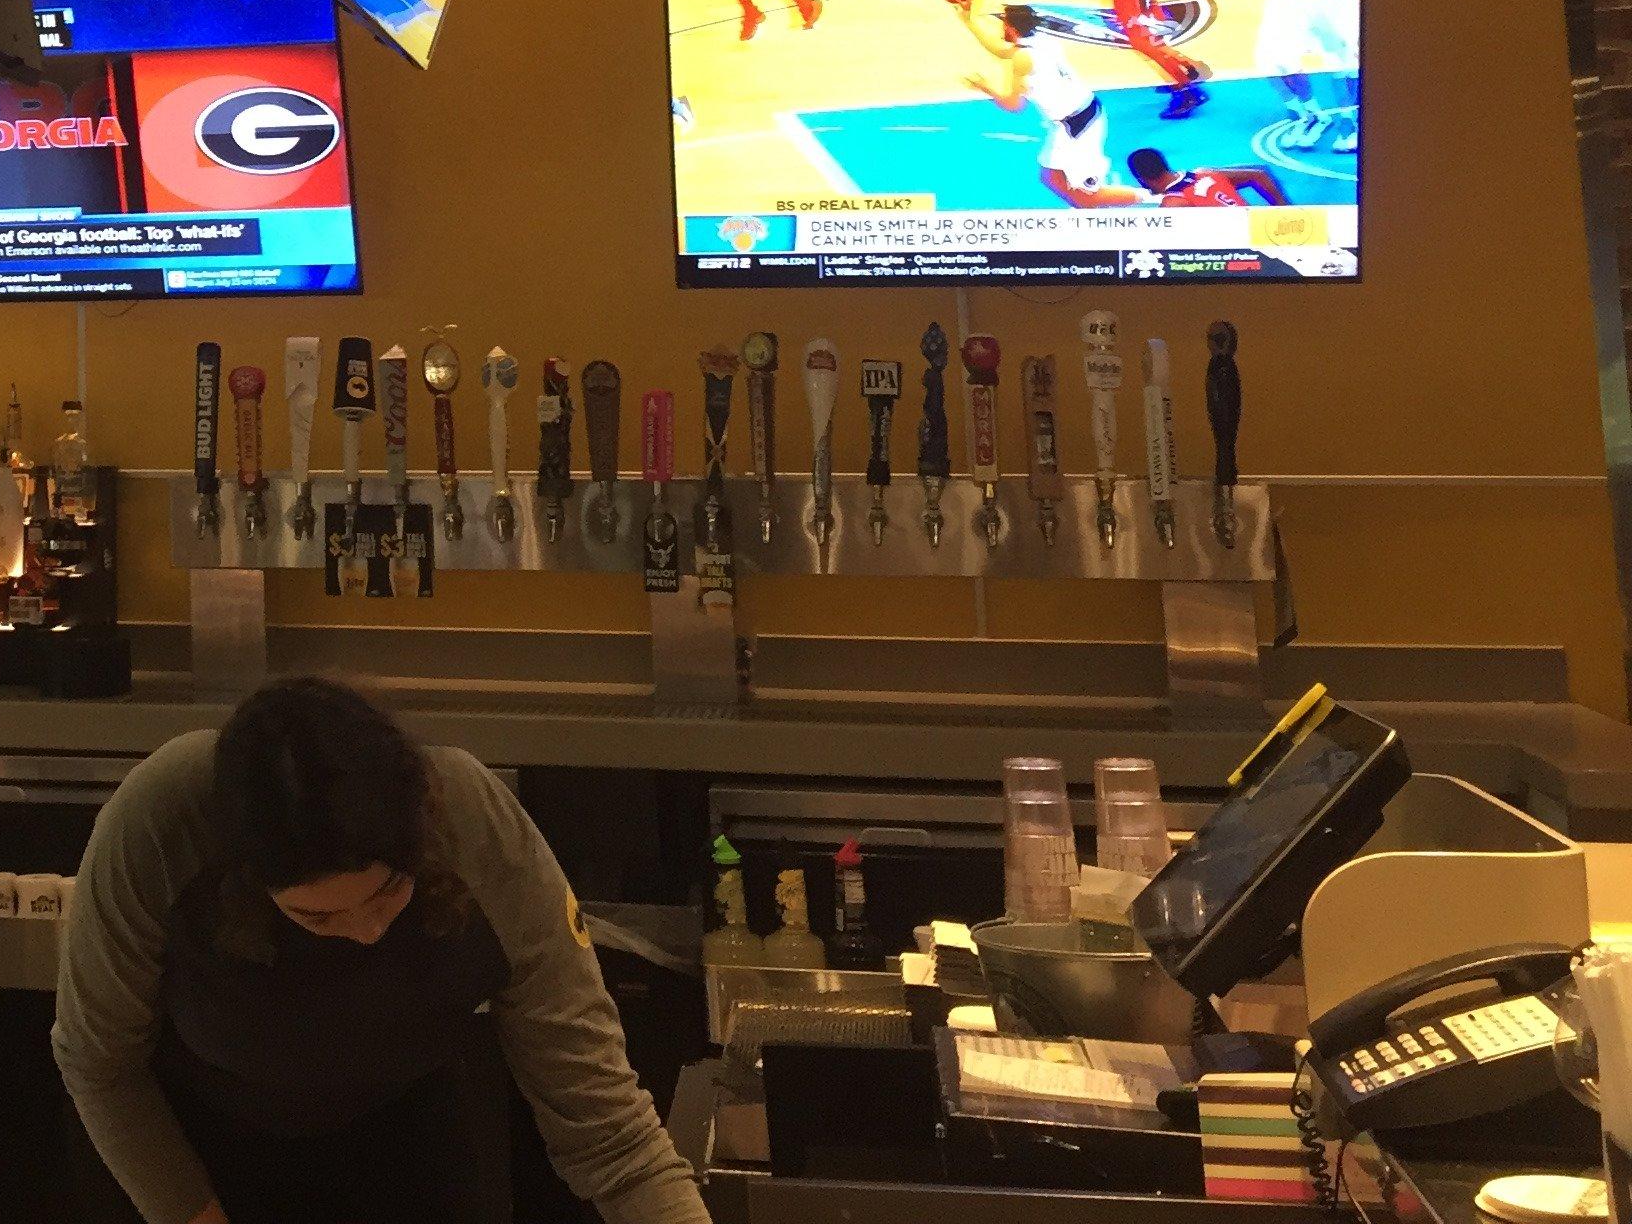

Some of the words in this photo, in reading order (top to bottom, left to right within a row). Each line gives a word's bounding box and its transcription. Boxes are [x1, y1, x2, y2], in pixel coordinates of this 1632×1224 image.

[229, 100, 339, 158] G
[776, 200, 795, 211] BS
[799, 201, 815, 210] or
[819, 200, 860, 211] REAL
[864, 198, 912, 210] TALK?
[811, 220, 872, 232] DENNIS
[878, 218, 928, 231] SMITH
[963, 218, 988, 230] ON
[1086, 216, 1138, 228] THINK
[1144, 215, 1173, 228] WE
[17, 228, 77, 246] Georgia
[79, 227, 142, 243] football:
[144, 226, 173, 243] Top
[811, 235, 847, 246] CAN
[852, 234, 878, 246] HIT
[884, 234, 915, 246] THE
[5, 246, 52, 257] Emerson
[54, 244, 101, 256] available
[104, 245, 119, 255] on
[120, 242, 202, 254] theathletic.com
[913, 254, 988, 265] Quarterfinals
[865, 369, 896, 389] IPA
[198, 362, 215, 417] LIGHT
[197, 418, 212, 459] BUD
